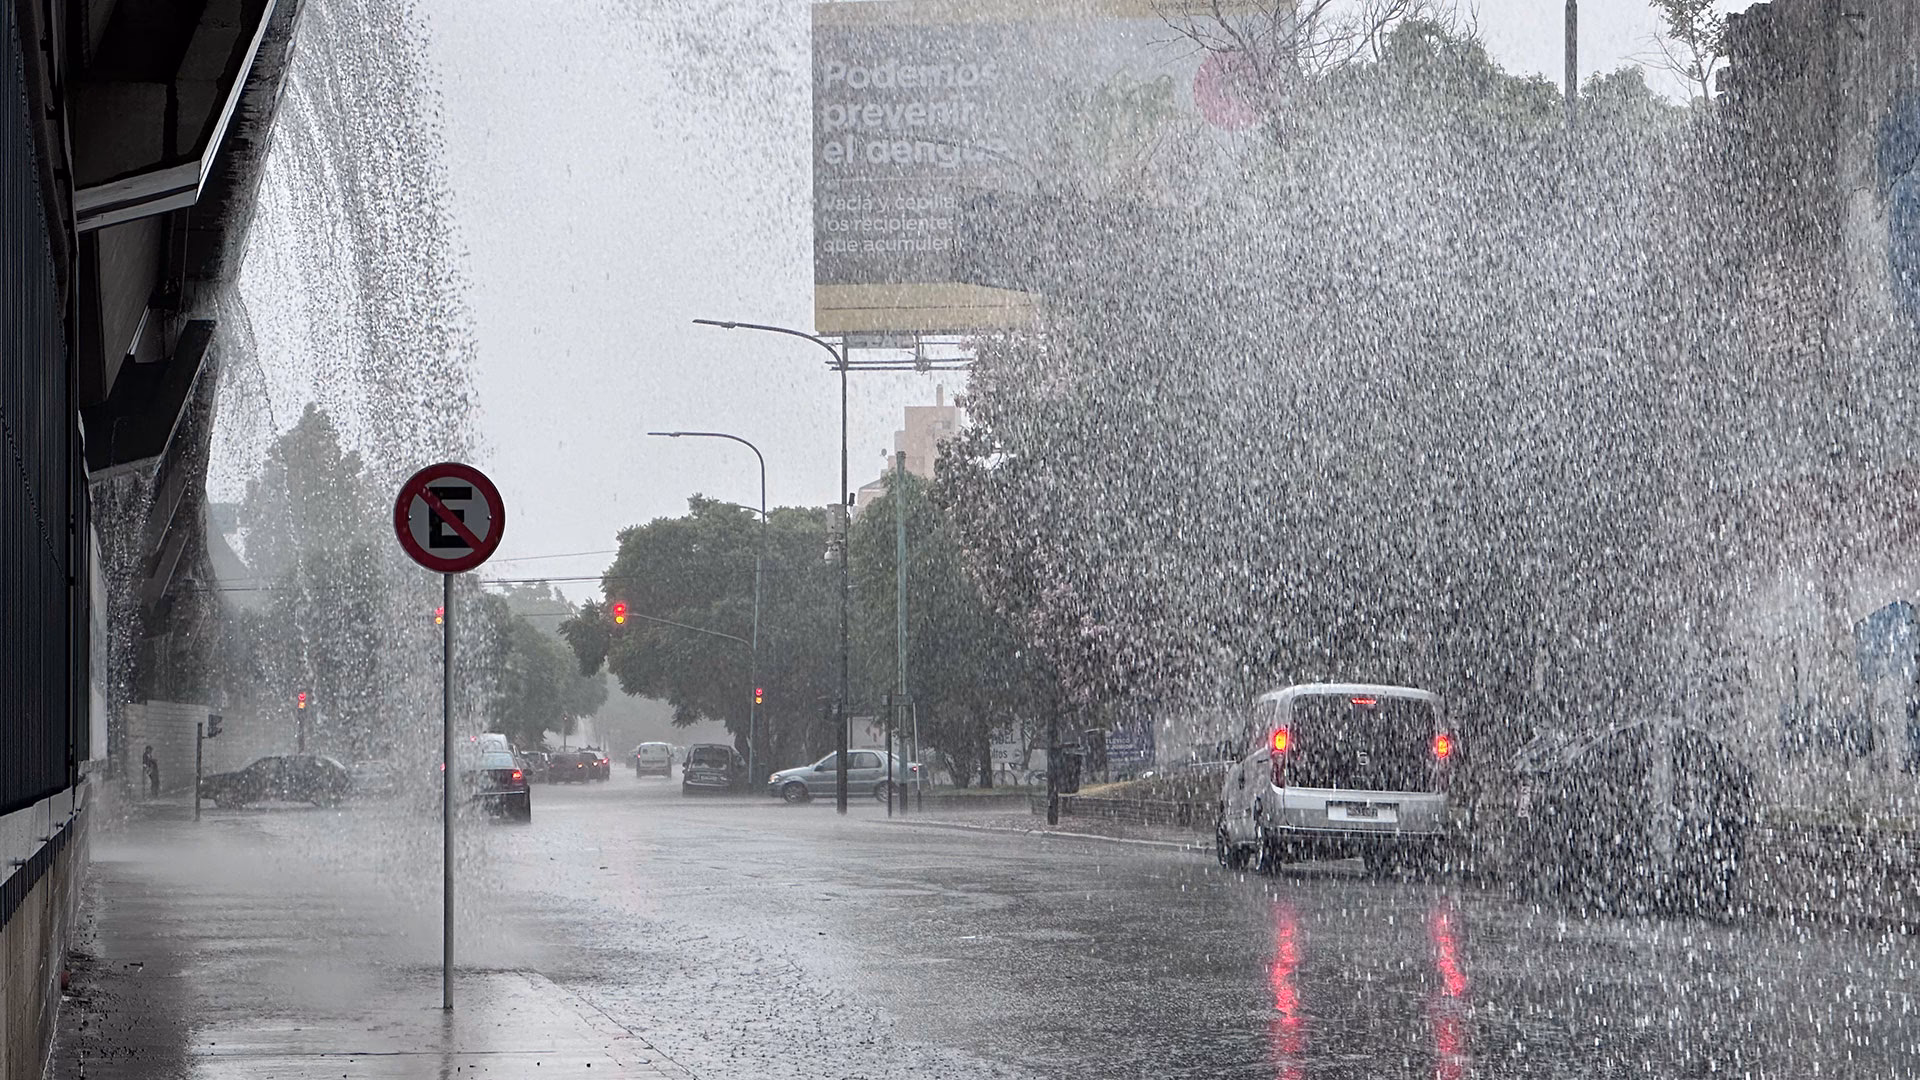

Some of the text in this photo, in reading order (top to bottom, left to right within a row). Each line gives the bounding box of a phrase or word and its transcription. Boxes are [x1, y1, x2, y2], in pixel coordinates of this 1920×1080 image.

[823, 59, 999, 90] Podemos
[822, 98, 975, 133] prevenir
[823, 134, 1007, 170] el dengue
[877, 198, 889, 213] y
[822, 217, 849, 233] los
[822, 239, 858, 255] que
[429, 487, 472, 548] E
